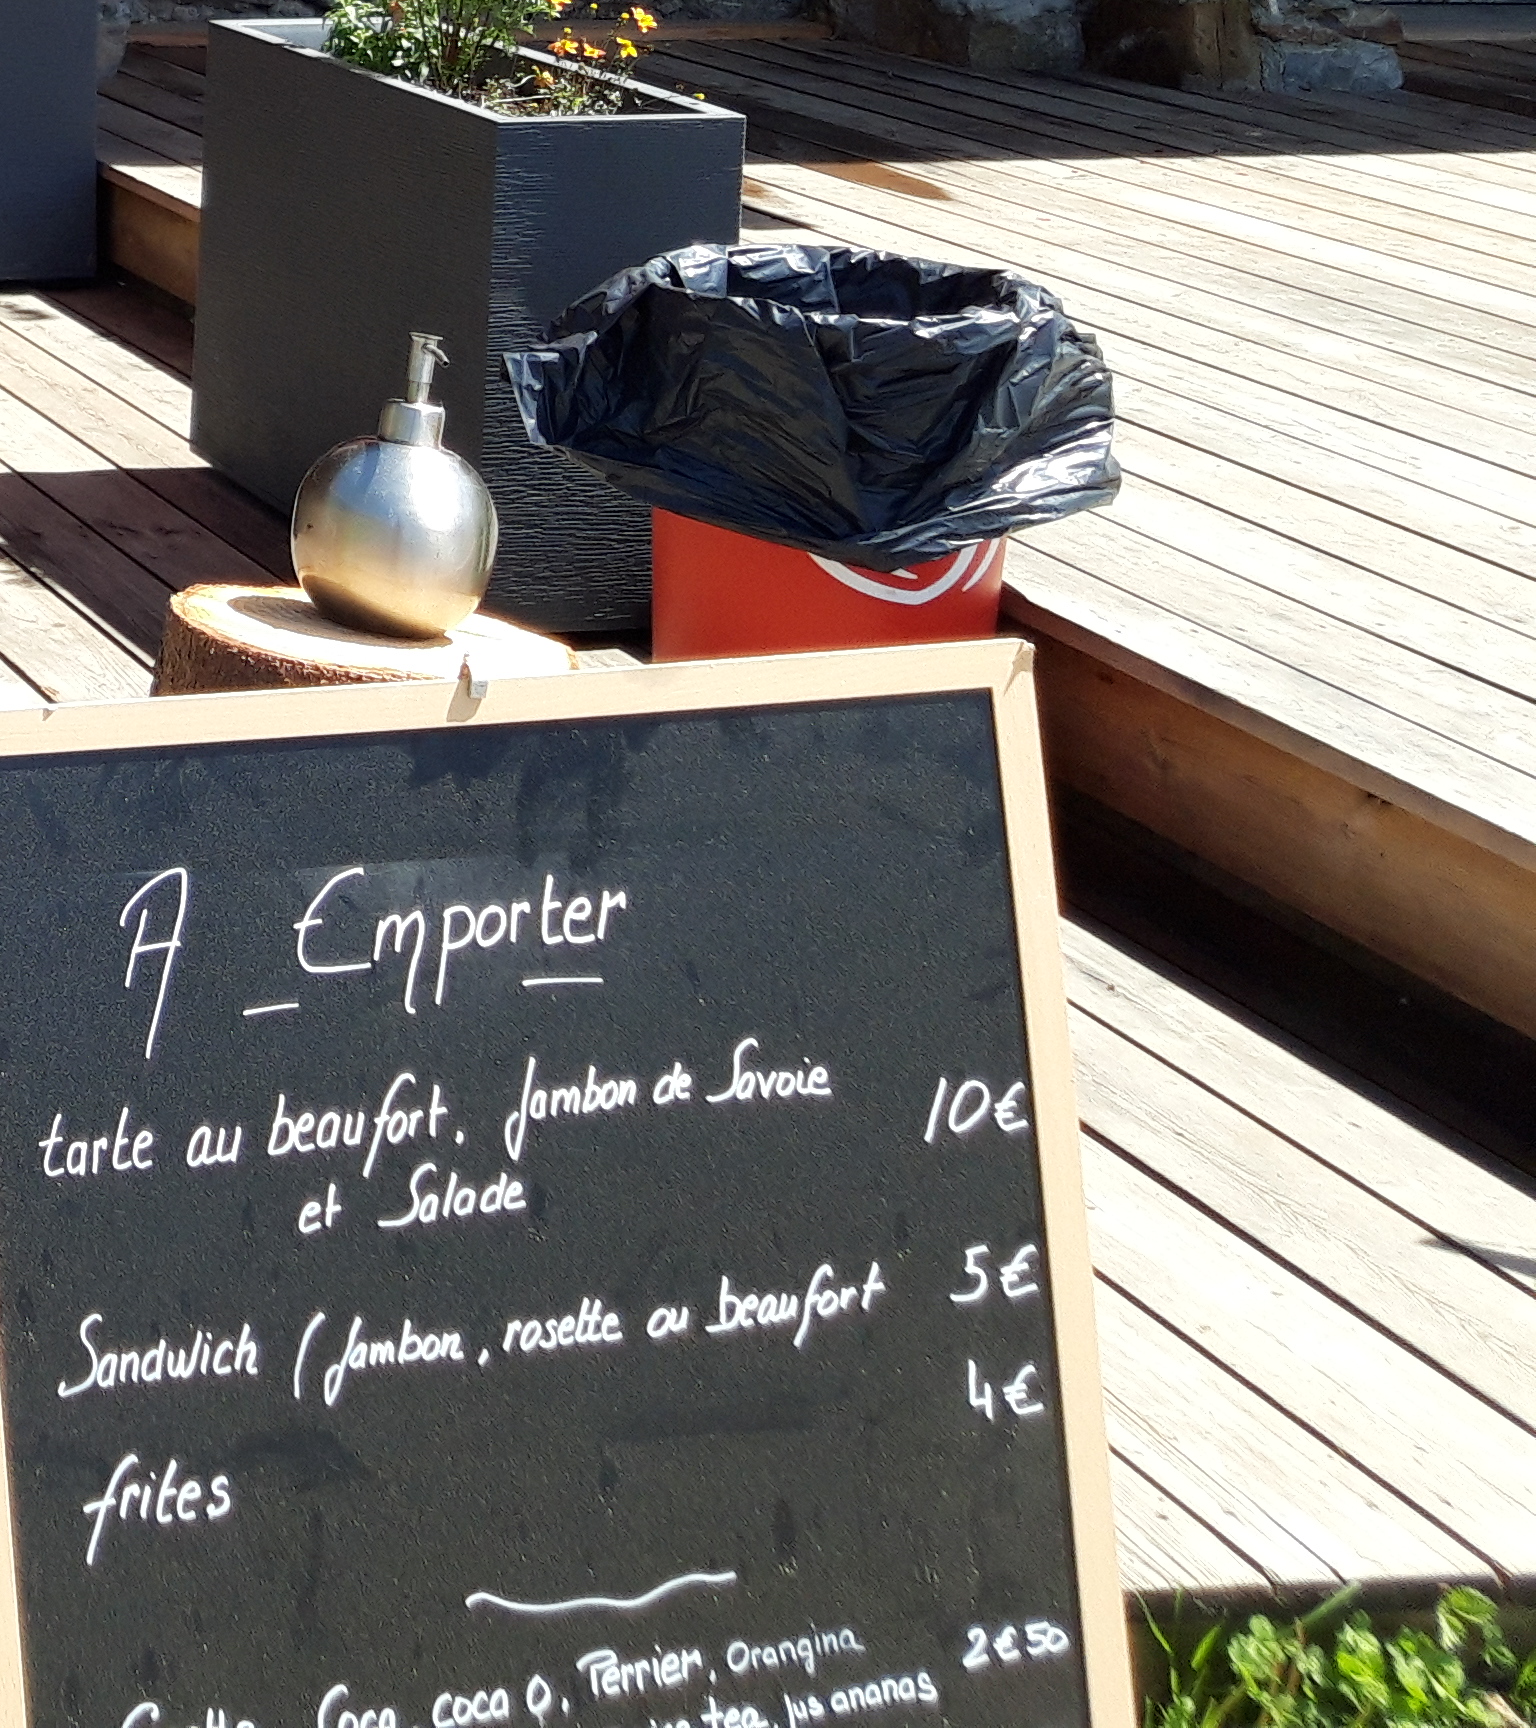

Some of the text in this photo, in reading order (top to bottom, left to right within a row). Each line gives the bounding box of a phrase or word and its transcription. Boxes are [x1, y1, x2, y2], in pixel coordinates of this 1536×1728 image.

[292, 866, 628, 1014] Emporter
[38, 1105, 155, 1178] tarte
[185, 1124, 243, 1168] au
[651, 1060, 693, 1106] de
[704, 1036, 833, 1104] Savoie
[922, 1075, 1030, 1144] 10€
[297, 1161, 528, 1235] et Salade
[56, 1312, 259, 1400] Sandwich
[501, 1295, 624, 1353] rosette
[645, 1304, 690, 1340] ou
[703, 1260, 887, 1350] beaufort
[948, 1242, 1040, 1304] 5€
[81, 1358, 1045, 1568] frites 4€
[431, 1687, 511, 1728] coca
[726, 1625, 866, 1675] Orangina
[960, 1620, 1073, 1672] 2€50
[830, 1670, 940, 1716] ananas
